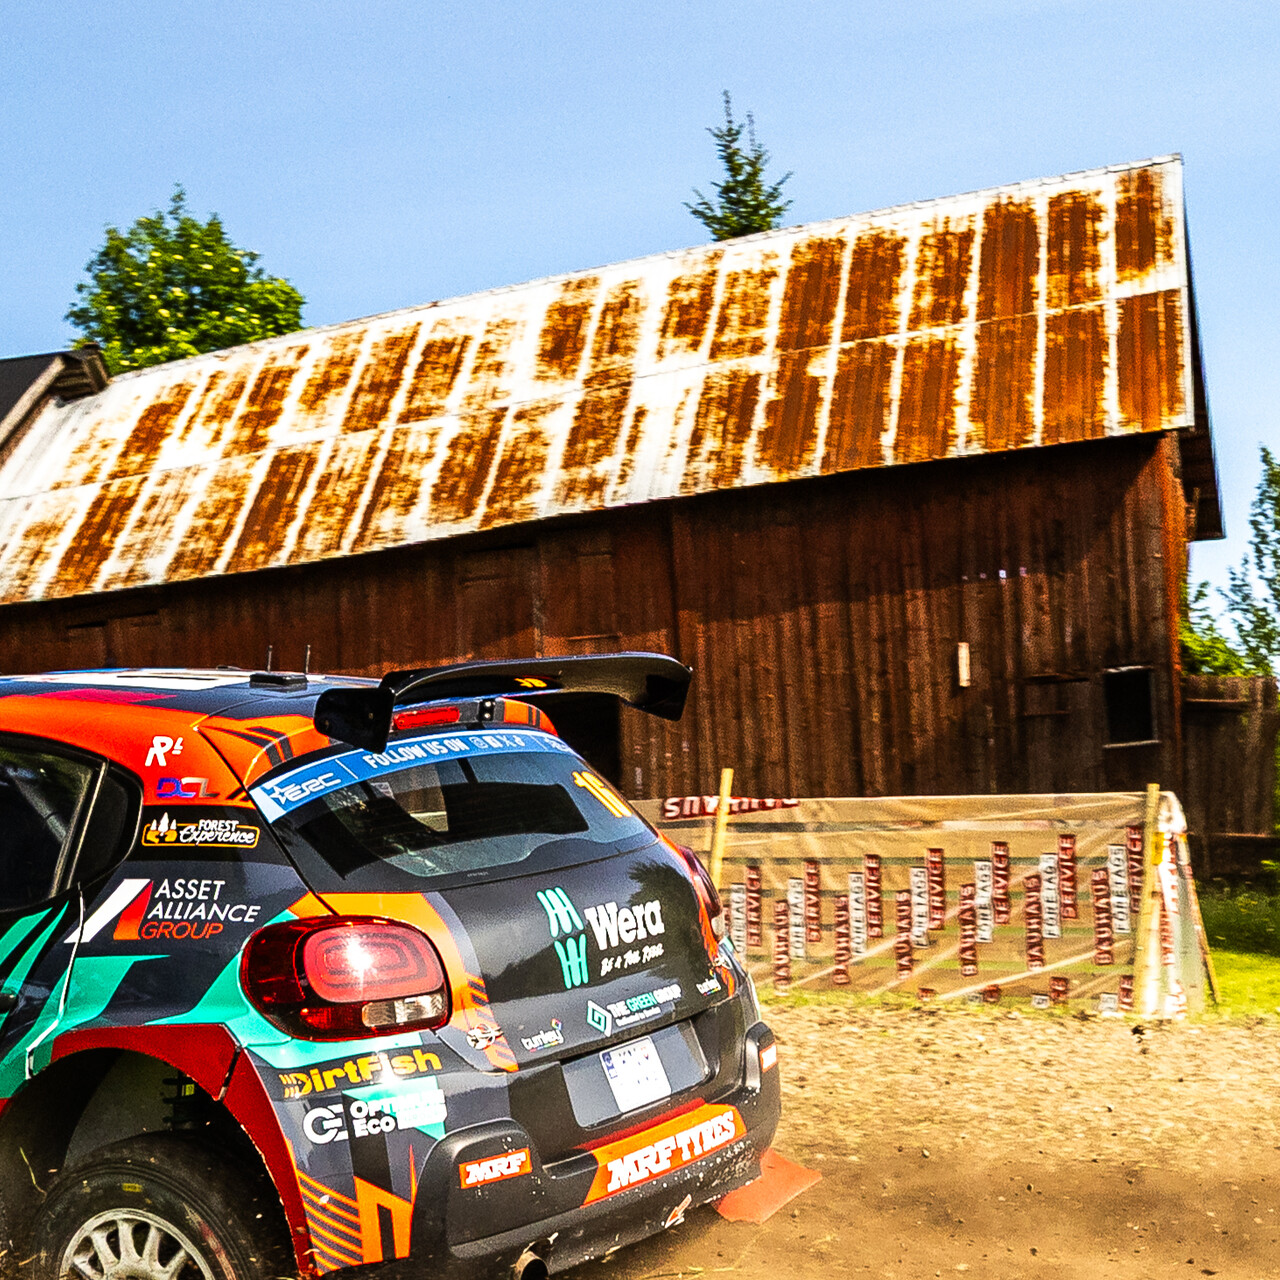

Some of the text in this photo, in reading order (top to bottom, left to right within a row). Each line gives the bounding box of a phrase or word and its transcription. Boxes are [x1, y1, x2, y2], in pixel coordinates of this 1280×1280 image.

[362, 738, 471, 769] FOLLOW US ON
[572, 771, 633, 818] 16
[179, 825, 256, 846] Experience
[197, 819, 240, 833] FOREST
[154, 878, 225, 900] ASSET
[147, 901, 261, 923] ALLIANCE
[584, 900, 665, 951] Wera
[140, 921, 223, 940] GROUP
[606, 1000, 631, 1018] THE
[625, 992, 658, 1012] GREEN
[652, 984, 681, 1004] GROUP
[353, 1115, 396, 1138] ECO
[607, 1110, 736, 1193] MRF TYRES
[465, 1151, 527, 1186] MRF
